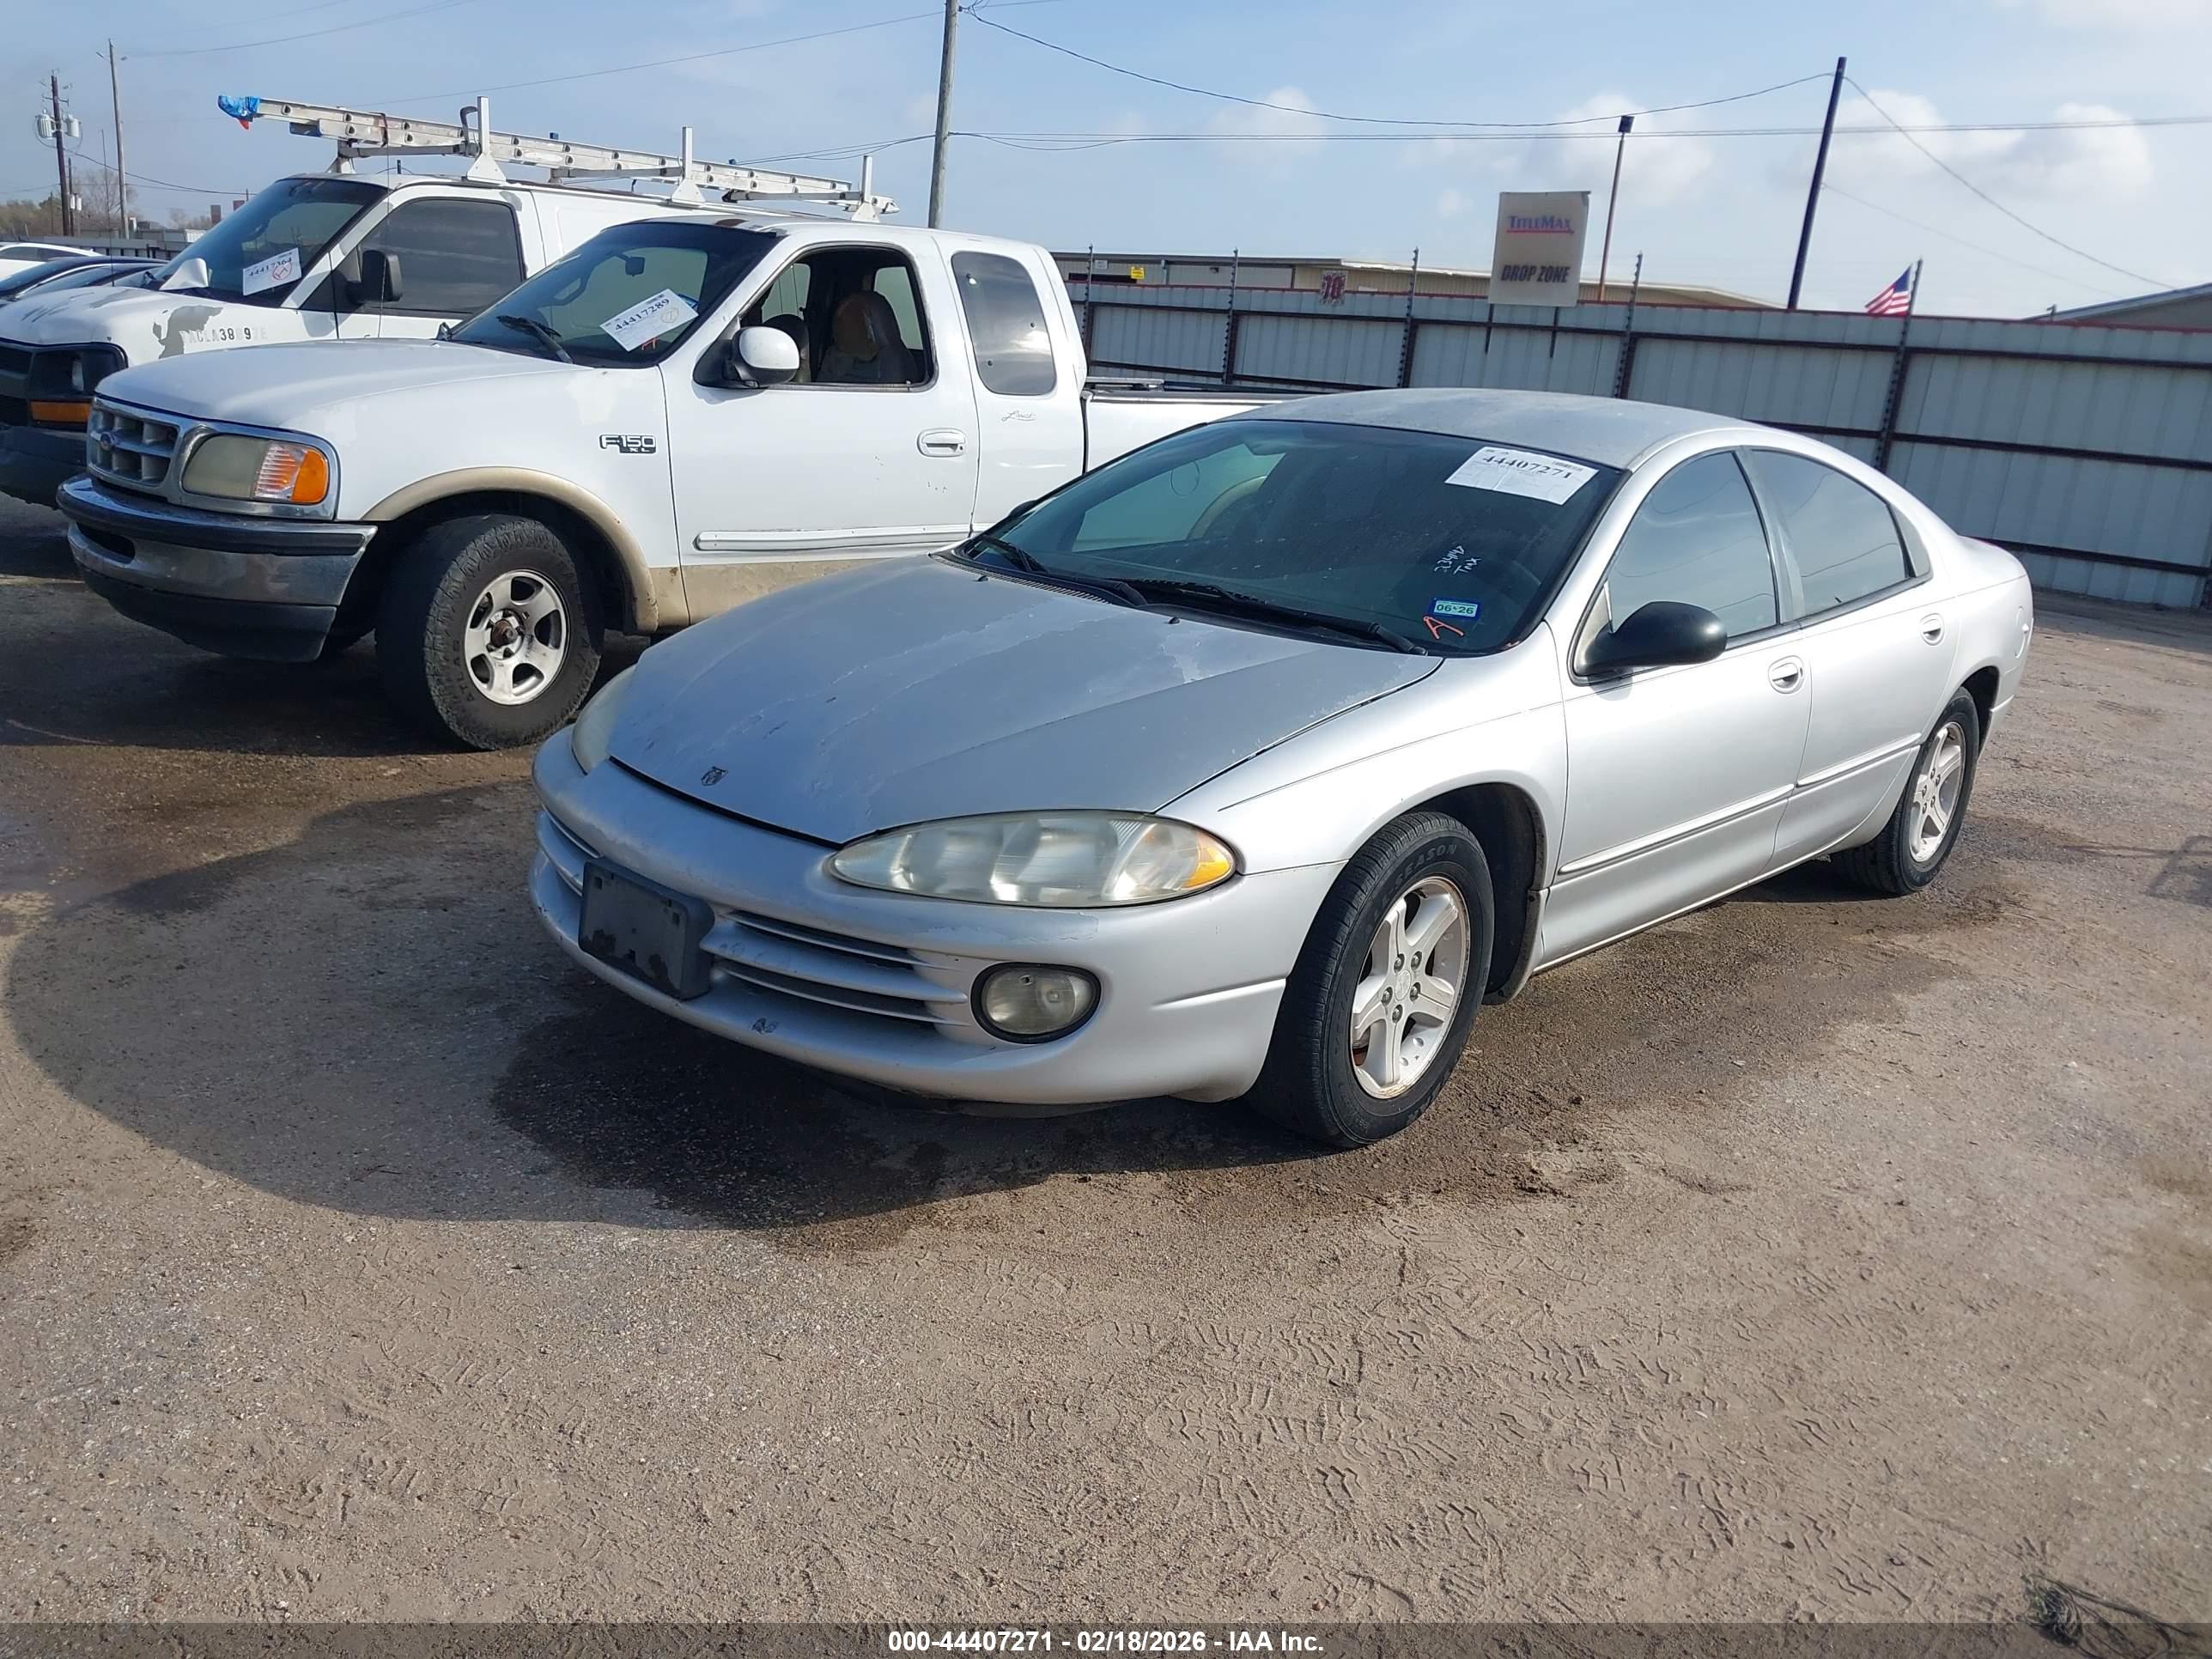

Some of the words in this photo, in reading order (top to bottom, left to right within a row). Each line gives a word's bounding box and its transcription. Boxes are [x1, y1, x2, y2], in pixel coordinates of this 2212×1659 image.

[1500, 264, 1537, 283] DROP
[1536, 265, 1571, 283] ZONE
[615, 298, 671, 331] 44417289
[1483, 455, 1573, 479] 44407271
